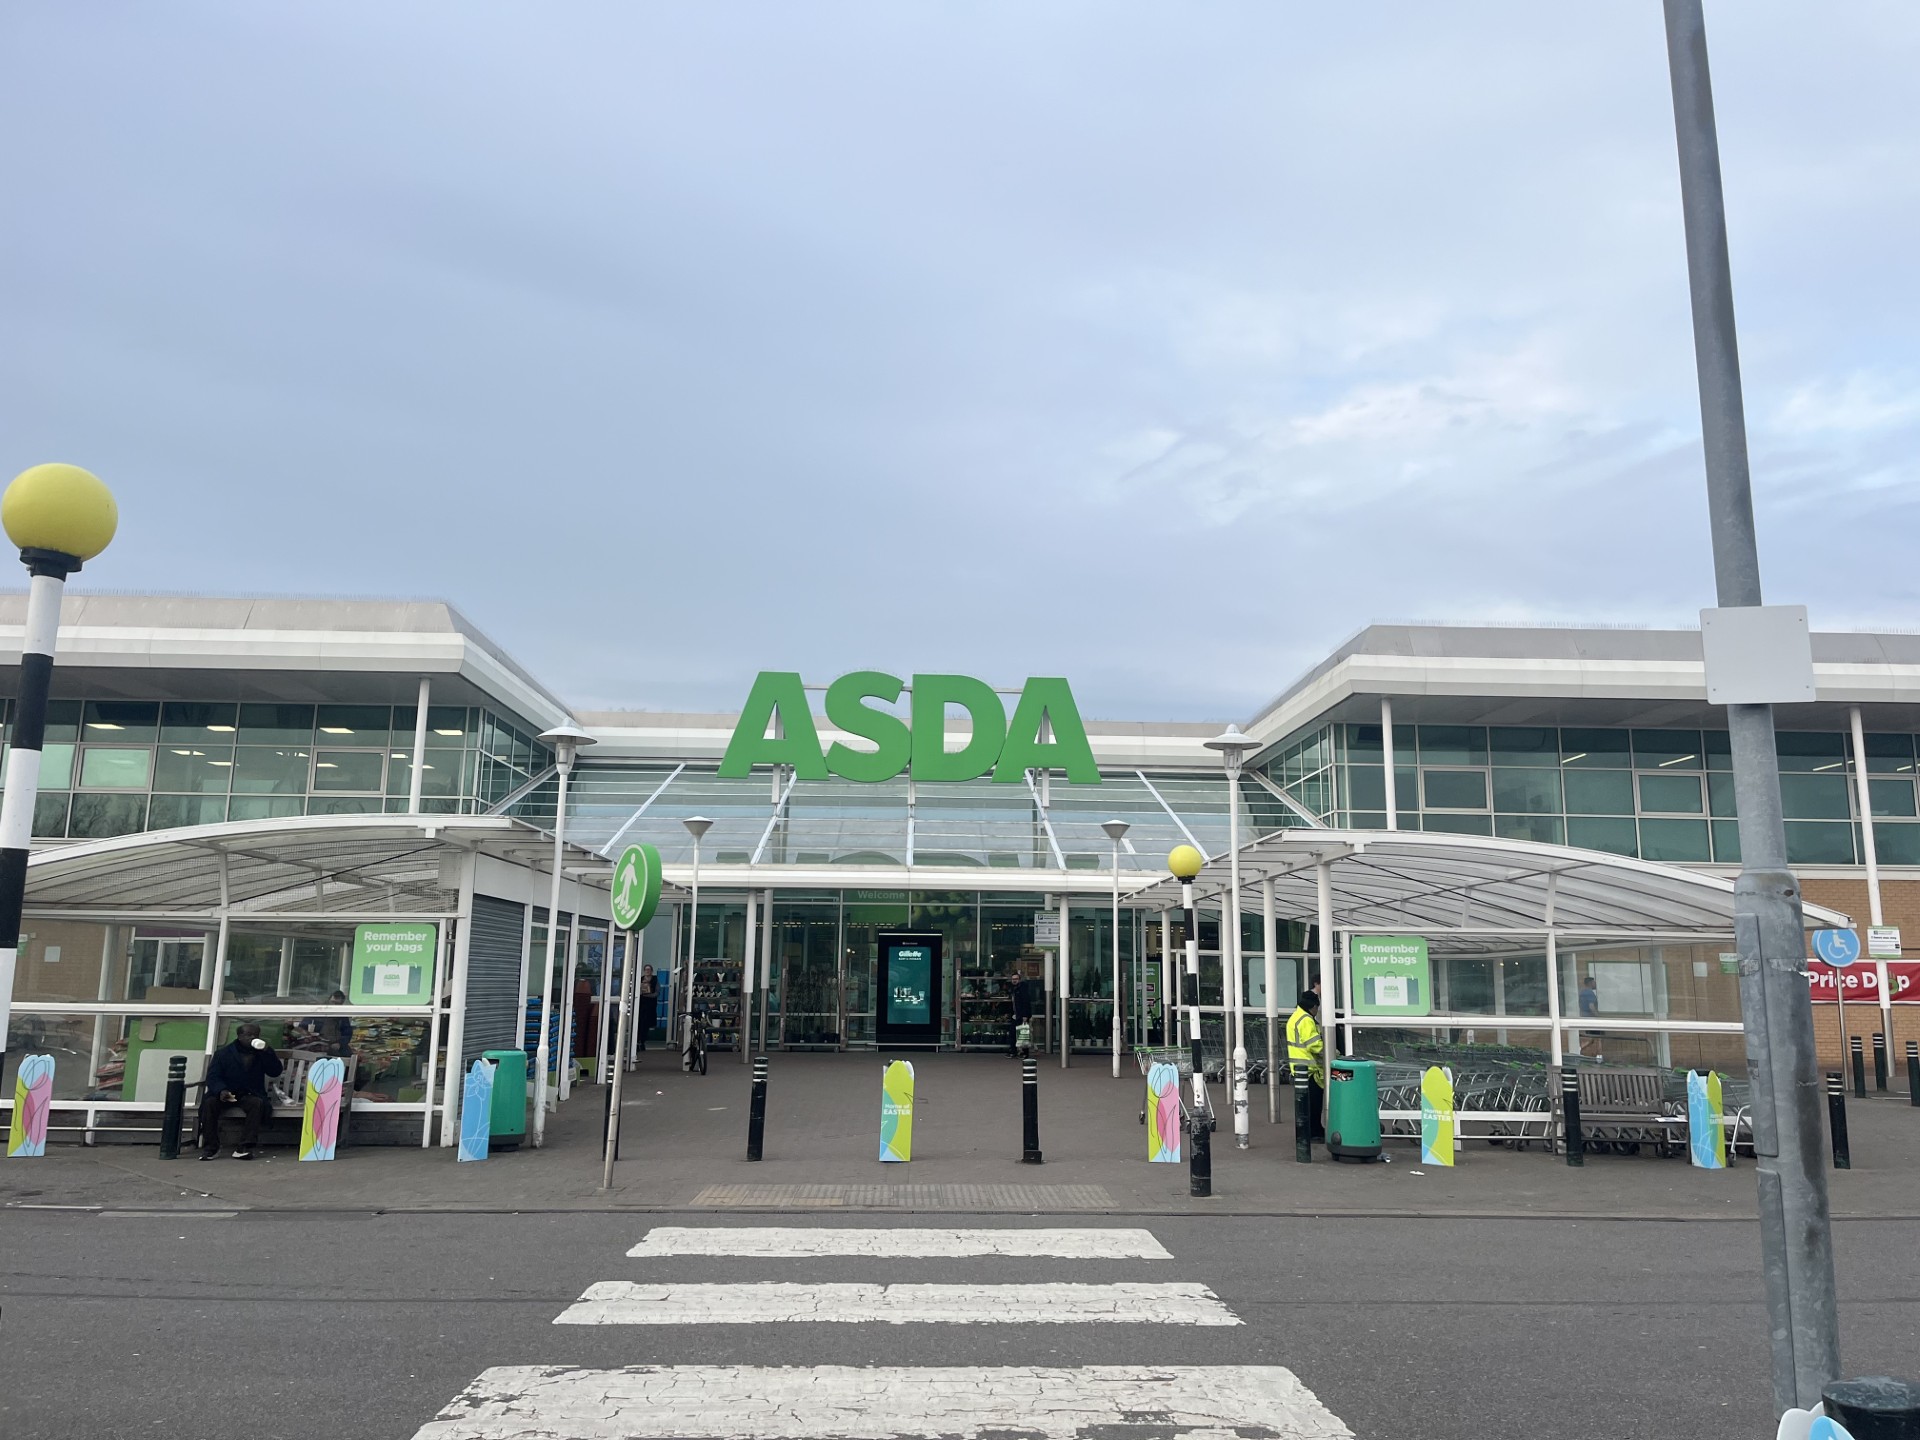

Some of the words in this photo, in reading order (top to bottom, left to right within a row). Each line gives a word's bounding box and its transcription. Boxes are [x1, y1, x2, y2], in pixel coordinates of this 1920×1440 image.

[716, 670, 1102, 785] ASDA
[857, 890, 905, 899] Welcome
[364, 931, 427, 941] Remember
[366, 943, 393, 953] your
[394, 942, 423, 953] bags
[1360, 944, 1420, 953] Remember
[1363, 956, 1388, 965] your
[1390, 955, 1417, 965] bags
[1808, 971, 1858, 988] Price
[1862, 971, 1910, 995] Dop
[1423, 1113, 1451, 1121] EASTER
